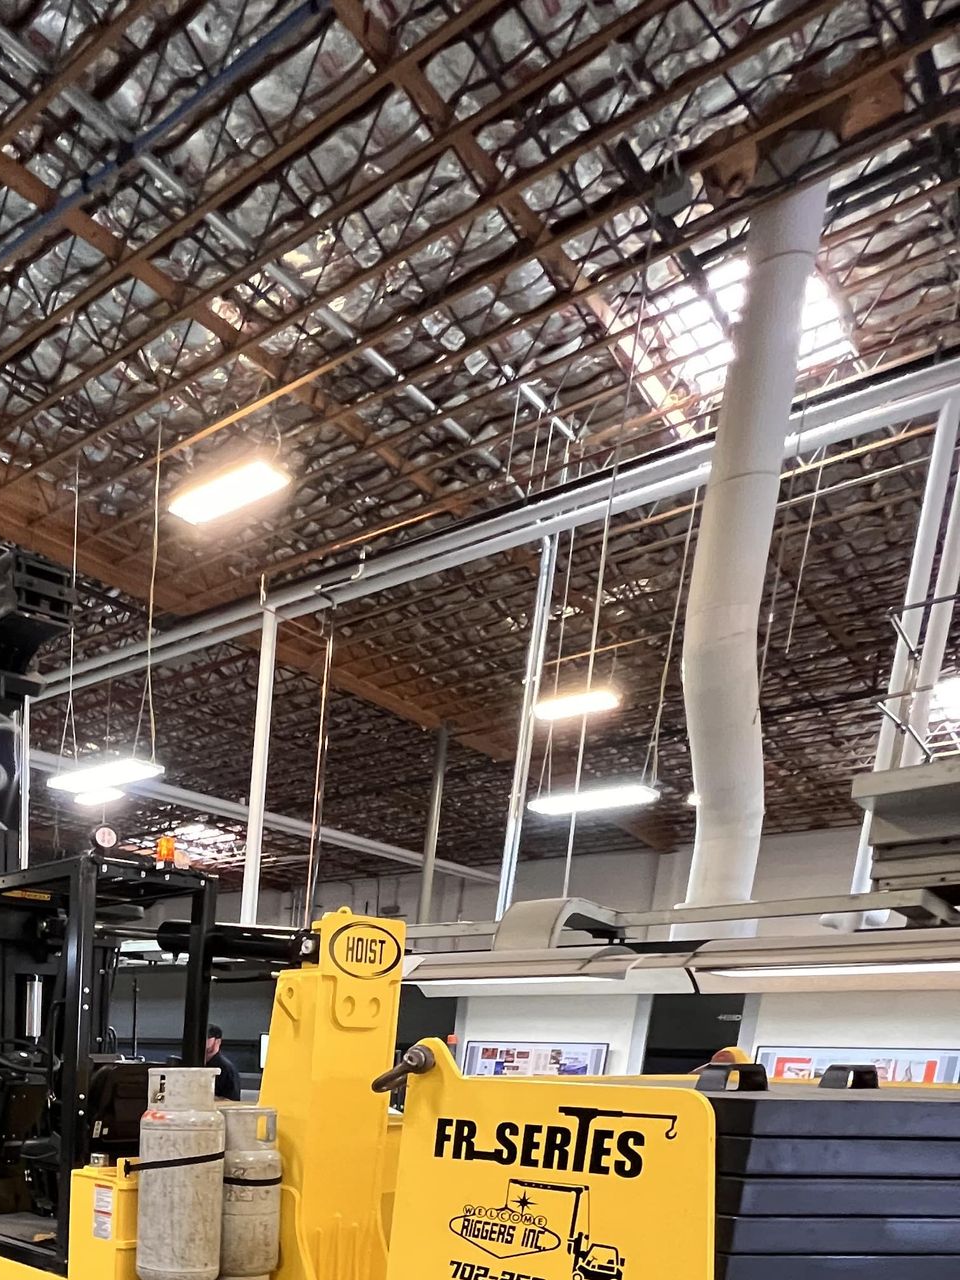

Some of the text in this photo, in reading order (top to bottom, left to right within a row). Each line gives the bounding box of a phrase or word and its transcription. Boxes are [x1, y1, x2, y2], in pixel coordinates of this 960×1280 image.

[345, 935, 387, 965] HOIST
[434, 1117, 477, 1161] FR
[463, 1204, 547, 1228] WELCOME
[460, 1217, 516, 1244] RIGGERS
